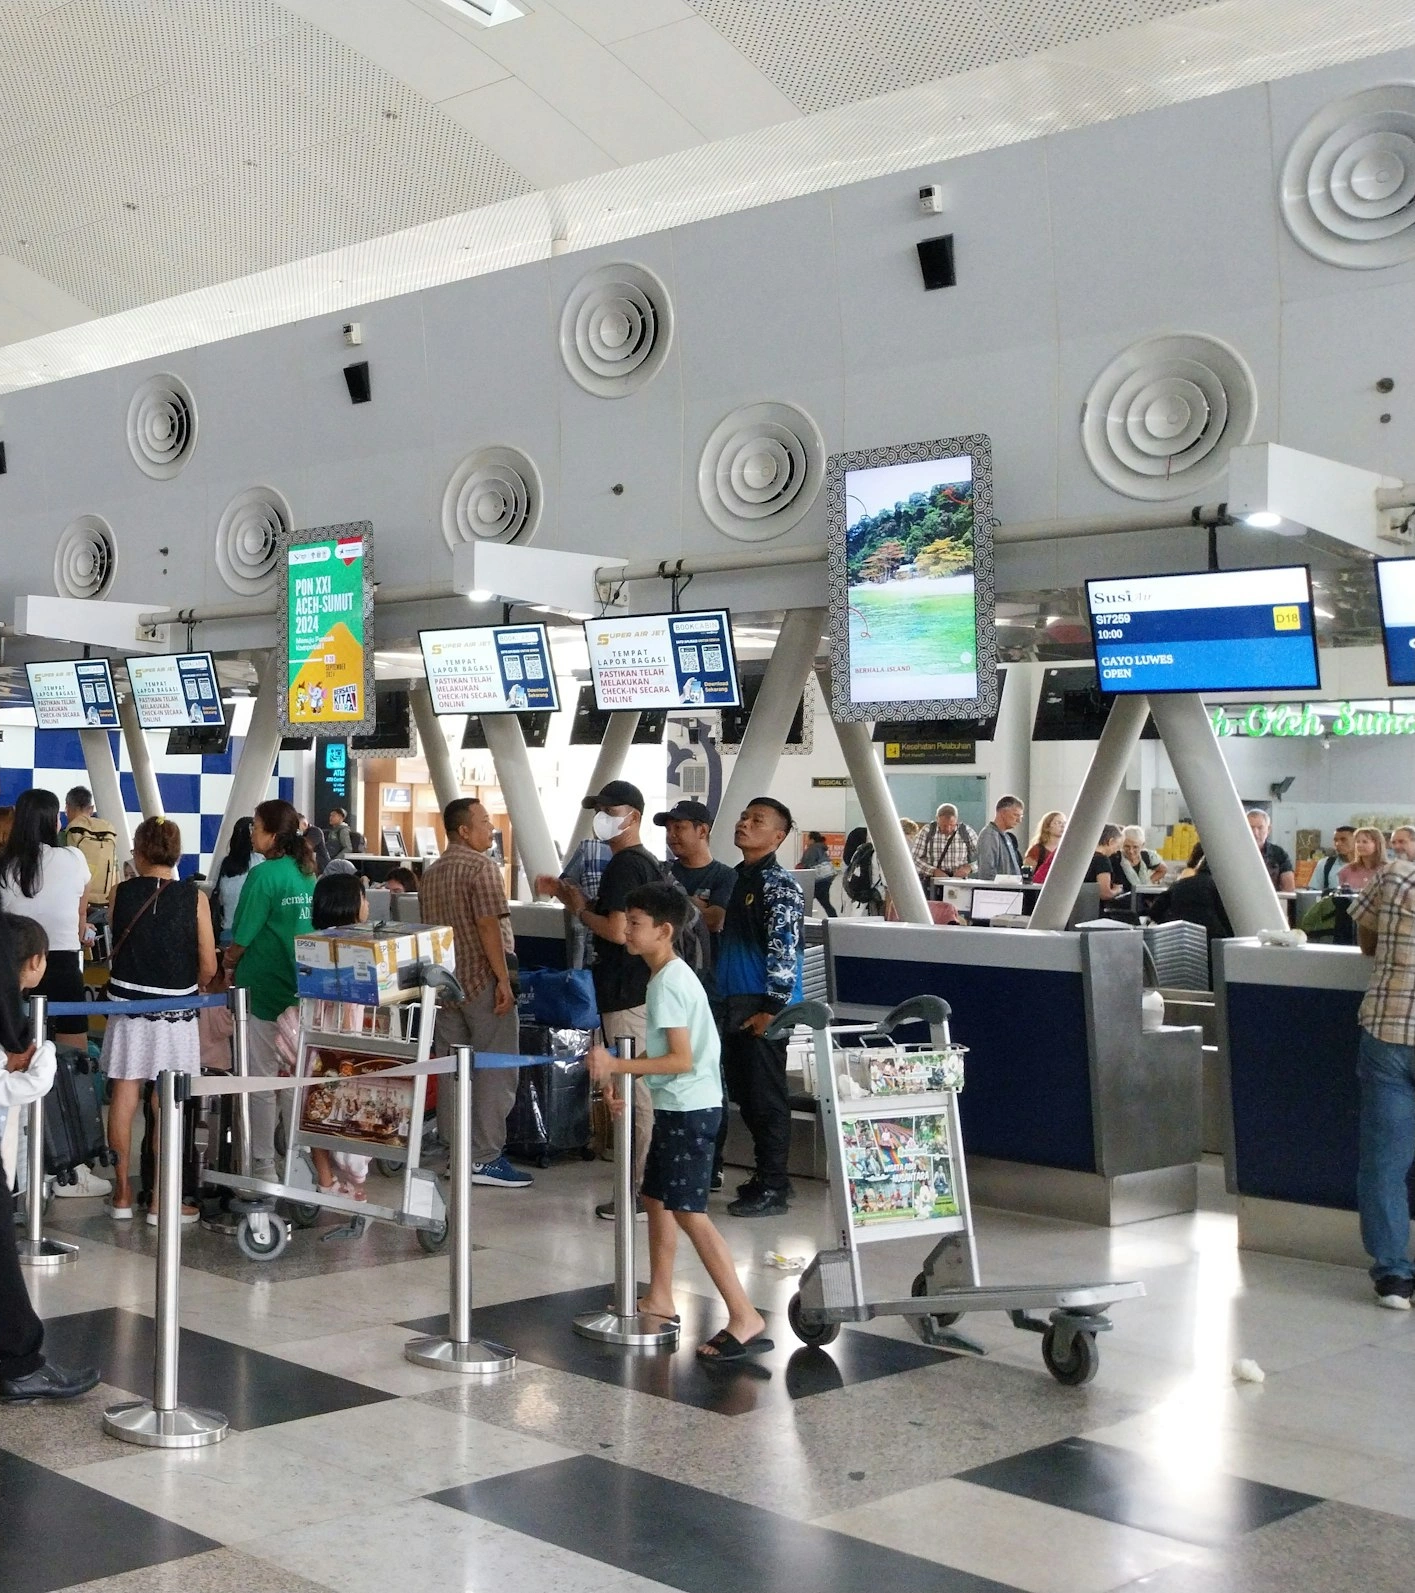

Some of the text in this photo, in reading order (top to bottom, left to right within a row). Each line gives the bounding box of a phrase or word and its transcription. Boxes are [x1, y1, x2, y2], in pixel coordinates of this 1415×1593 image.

[295, 575, 331, 597] PON XXI
[1094, 590, 1132, 604] Susi
[295, 592, 354, 616] ACEH-SUMUT
[1095, 613, 1131, 625] SI7259
[1275, 613, 1299, 624] D18
[295, 615, 319, 634] 2024
[675, 622, 718, 631] BOOKCABIN
[597, 631, 632, 645] SUPER
[1097, 629, 1123, 639] 10:00
[431, 643, 462, 654] SUPER
[597, 656, 666, 666] LAPOR BAGASI
[1101, 655, 1174, 667] GAYO LUWES
[599, 668, 665, 678] PASTIKAN TELAH
[855, 665, 911, 674] BERHALA ISLAND
[1103, 668, 1132, 679] OPEN
[600, 678, 650, 687] MELAKUKAN
[333, 685, 356, 695] BERSATU
[601, 687, 638, 695] CHECK-IN
[1211, 704, 1325, 737] h-Oleh
[936, 742, 972, 750] Pelabuhan
[281, 892, 304, 906] acmé
[296, 940, 317, 948] EPSON
